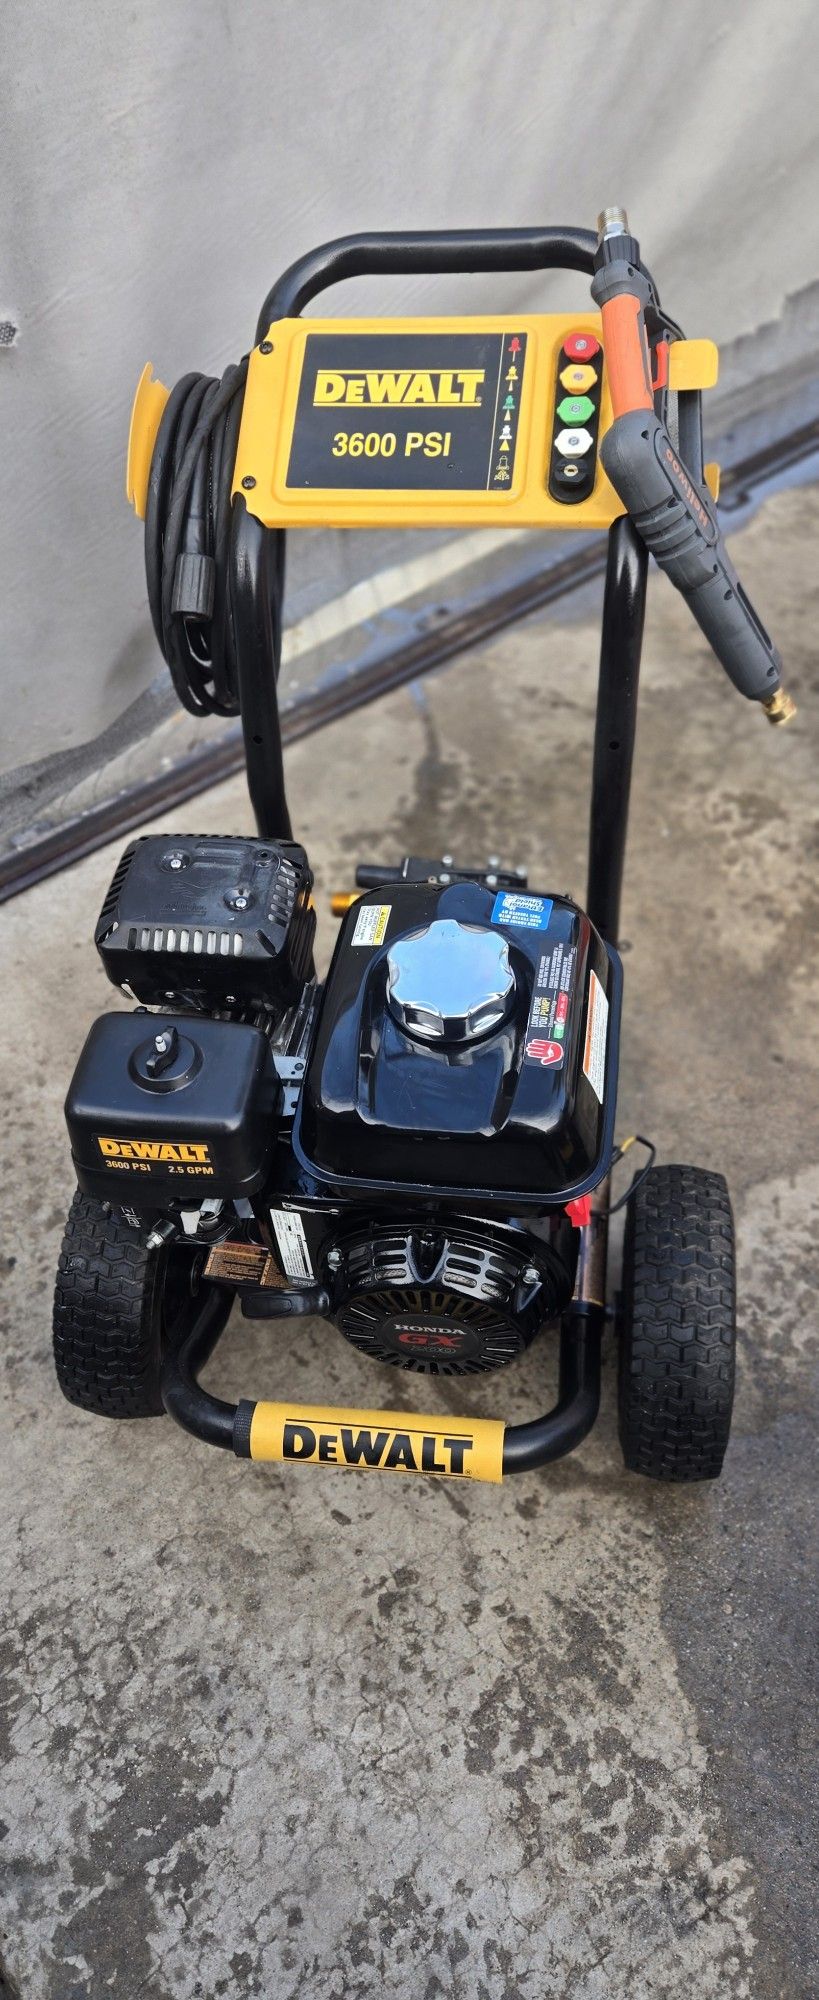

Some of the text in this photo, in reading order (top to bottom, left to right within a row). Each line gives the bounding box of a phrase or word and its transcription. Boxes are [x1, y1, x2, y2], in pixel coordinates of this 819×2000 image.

[314, 372, 485, 403] DEWALT
[332, 432, 452, 458] 3600 PSI
[375, 915, 387, 939] CAUTION
[531, 996, 542, 1028] LOOK BEFORE
[538, 1015, 548, 1028] YOU
[98, 1138, 209, 1162] DEWALT
[105, 1160, 152, 1172] 3600 PSI
[168, 1165, 214, 1175] 2.5 GPM
[393, 1323, 467, 1335] HONDA
[398, 1333, 464, 1348] GX
[282, 1423, 474, 1474] DEWALT
